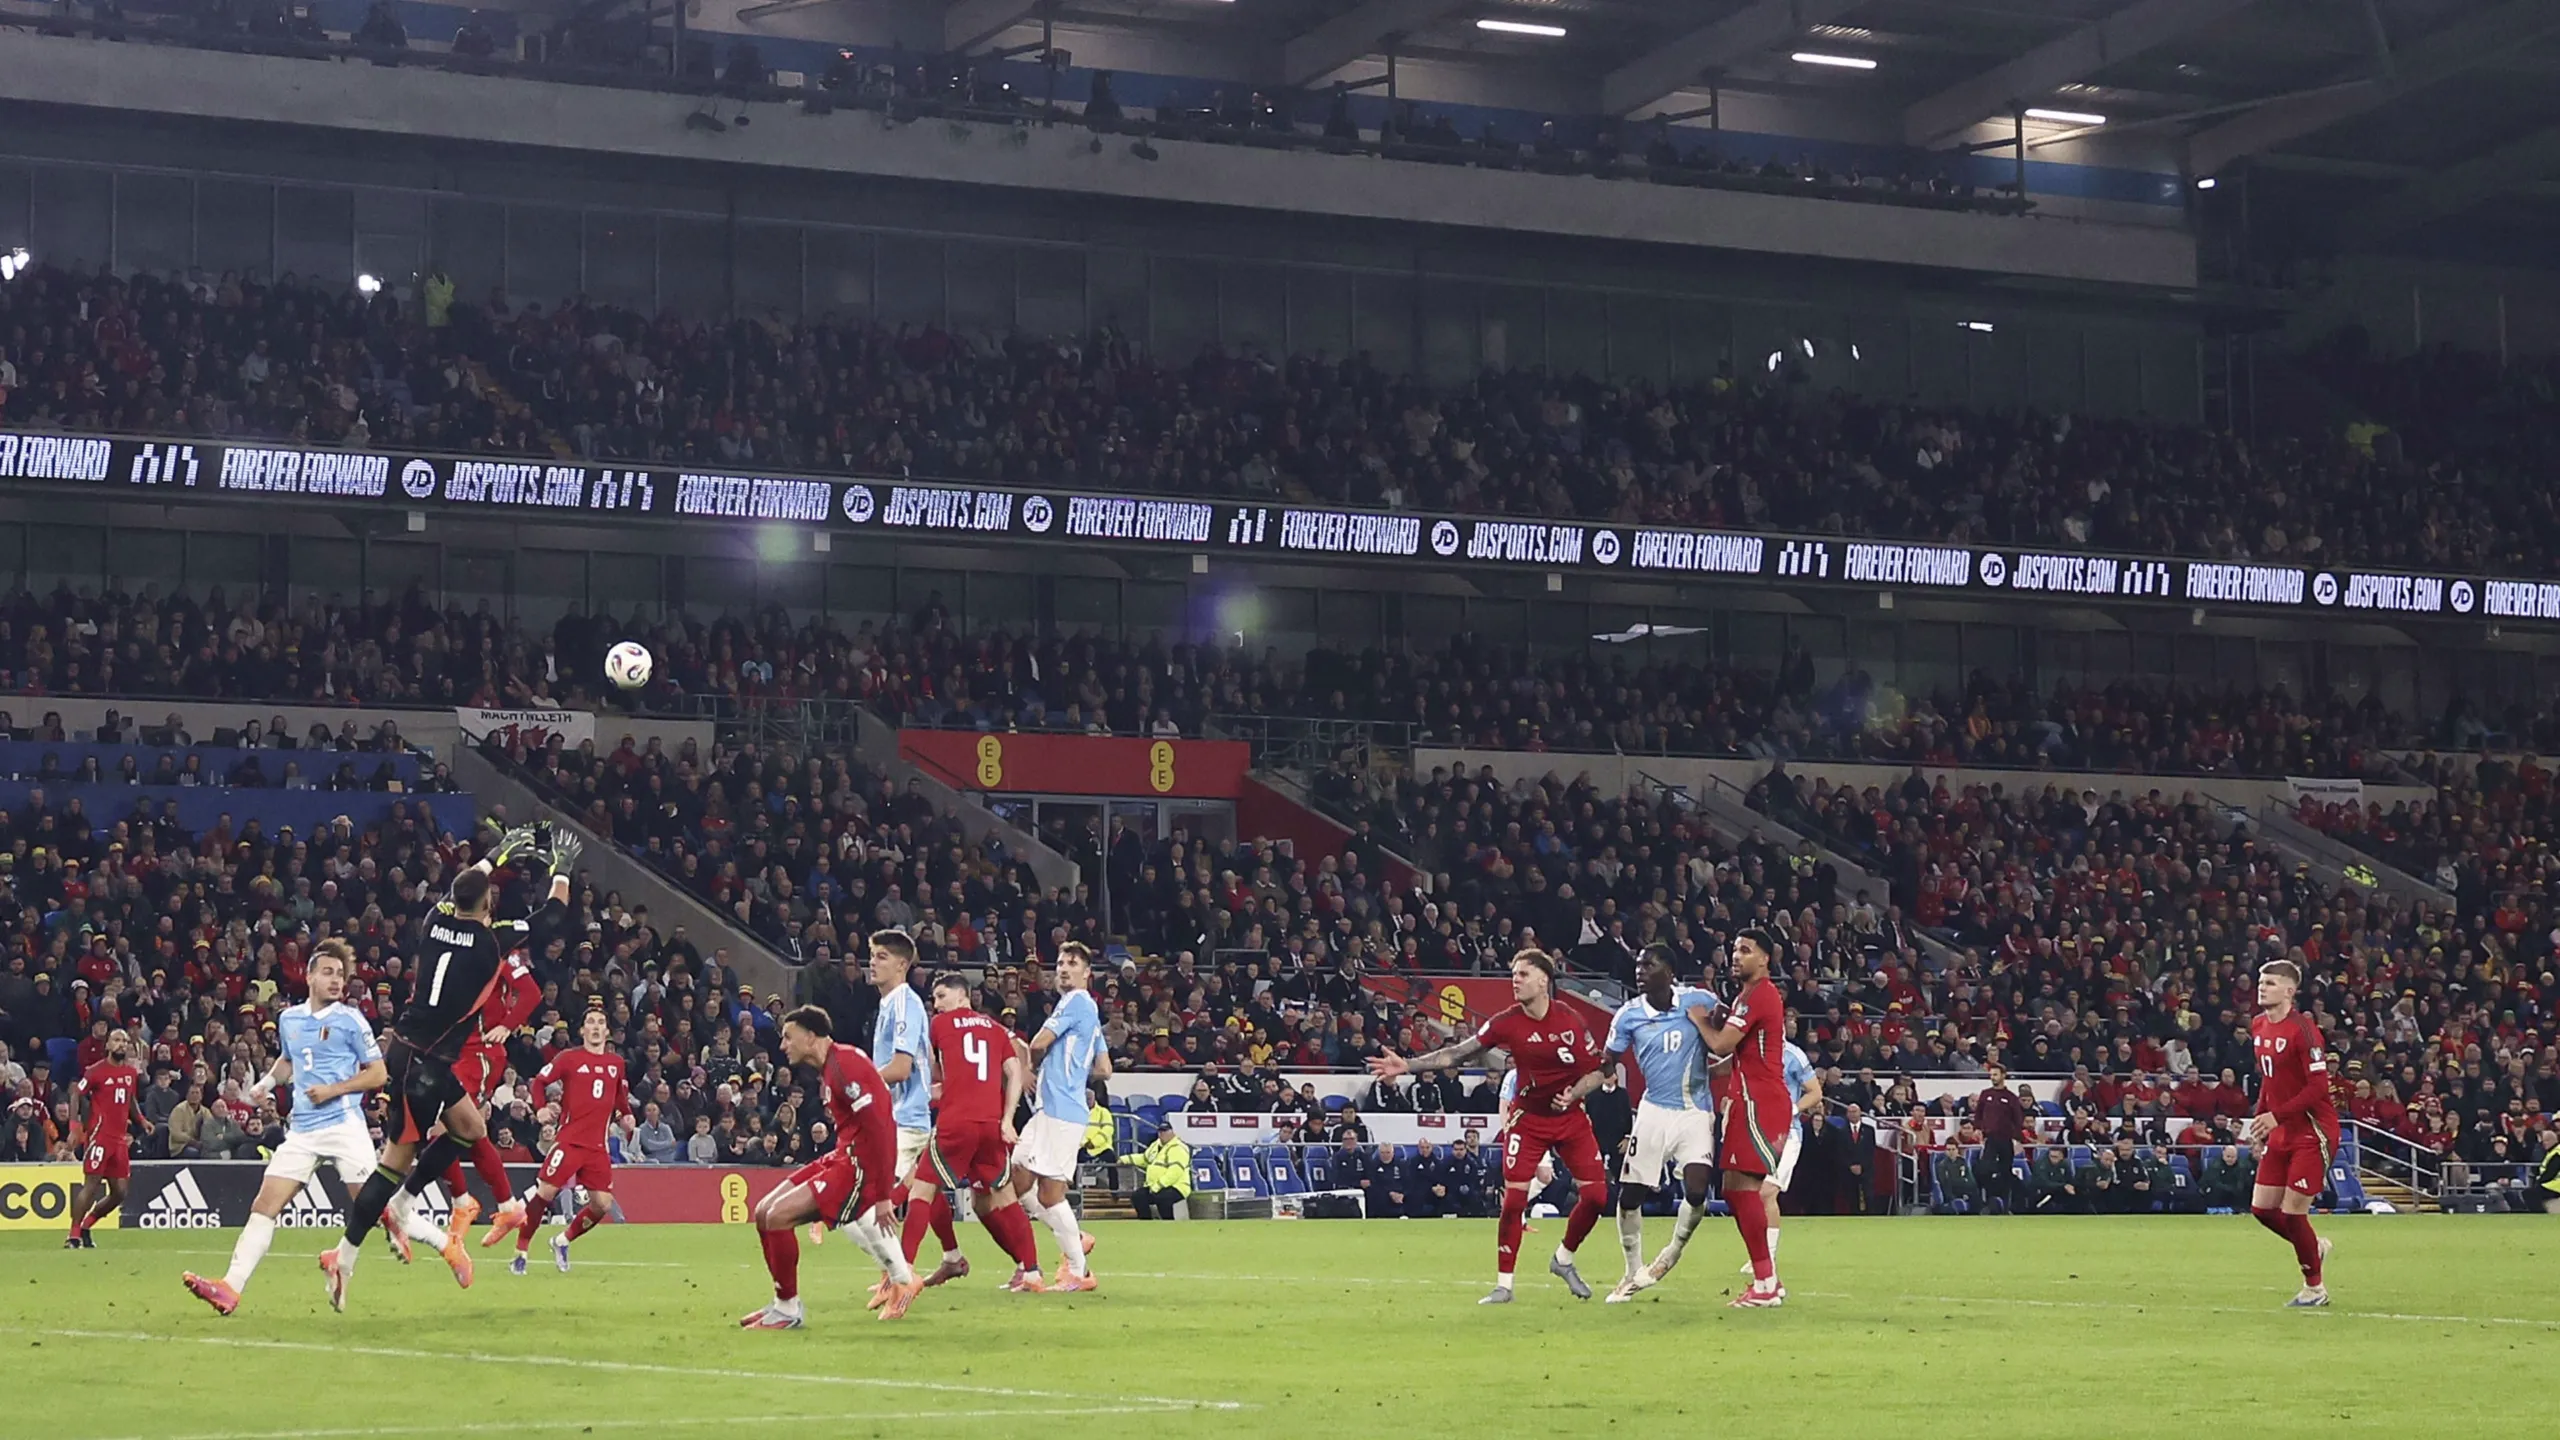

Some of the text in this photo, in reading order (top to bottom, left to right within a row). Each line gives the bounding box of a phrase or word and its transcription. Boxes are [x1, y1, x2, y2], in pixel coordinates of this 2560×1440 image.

[17, 436, 111, 481] FORWARD
[219, 448, 389, 496] FOREVER FORWARD
[445, 461, 585, 507] JDSPORTS.COM
[675, 474, 831, 521] FOREVER FORWARD
[883, 487, 1013, 531] JDSPORTS.COM
[1066, 497, 1212, 542] FOREVER FORWARD
[1280, 510, 1421, 556] FOREVER FORWARD
[1467, 522, 1583, 564] JDSPORTS.COM
[1632, 530, 1763, 573] FOREVER FORWARD
[1844, 544, 1970, 586] FOREVER FORWARD
[2013, 554, 2118, 594] JDSPORTS.COM
[2186, 563, 2305, 603] FOREVER FORWARD
[2344, 574, 2442, 612] JDSPORTS.COM
[2484, 580, 2538, 617] FOREVER
[430, 924, 474, 948] DARLOW
[428, 951, 453, 1007] 1
[301, 1047, 313, 1072] 3
[963, 1031, 988, 1082] 4
[1557, 1046, 1575, 1063] 6
[1663, 1030, 1682, 1054] 18
[2261, 1054, 2273, 1078] 17
[114, 1087, 126, 1104] 19
[592, 1079, 604, 1099] 8
[90, 1145, 104, 1162] 19
[550, 1149, 564, 1168] 8
[1508, 1133, 1522, 1156] 6
[139, 1208, 221, 1228] adidas
